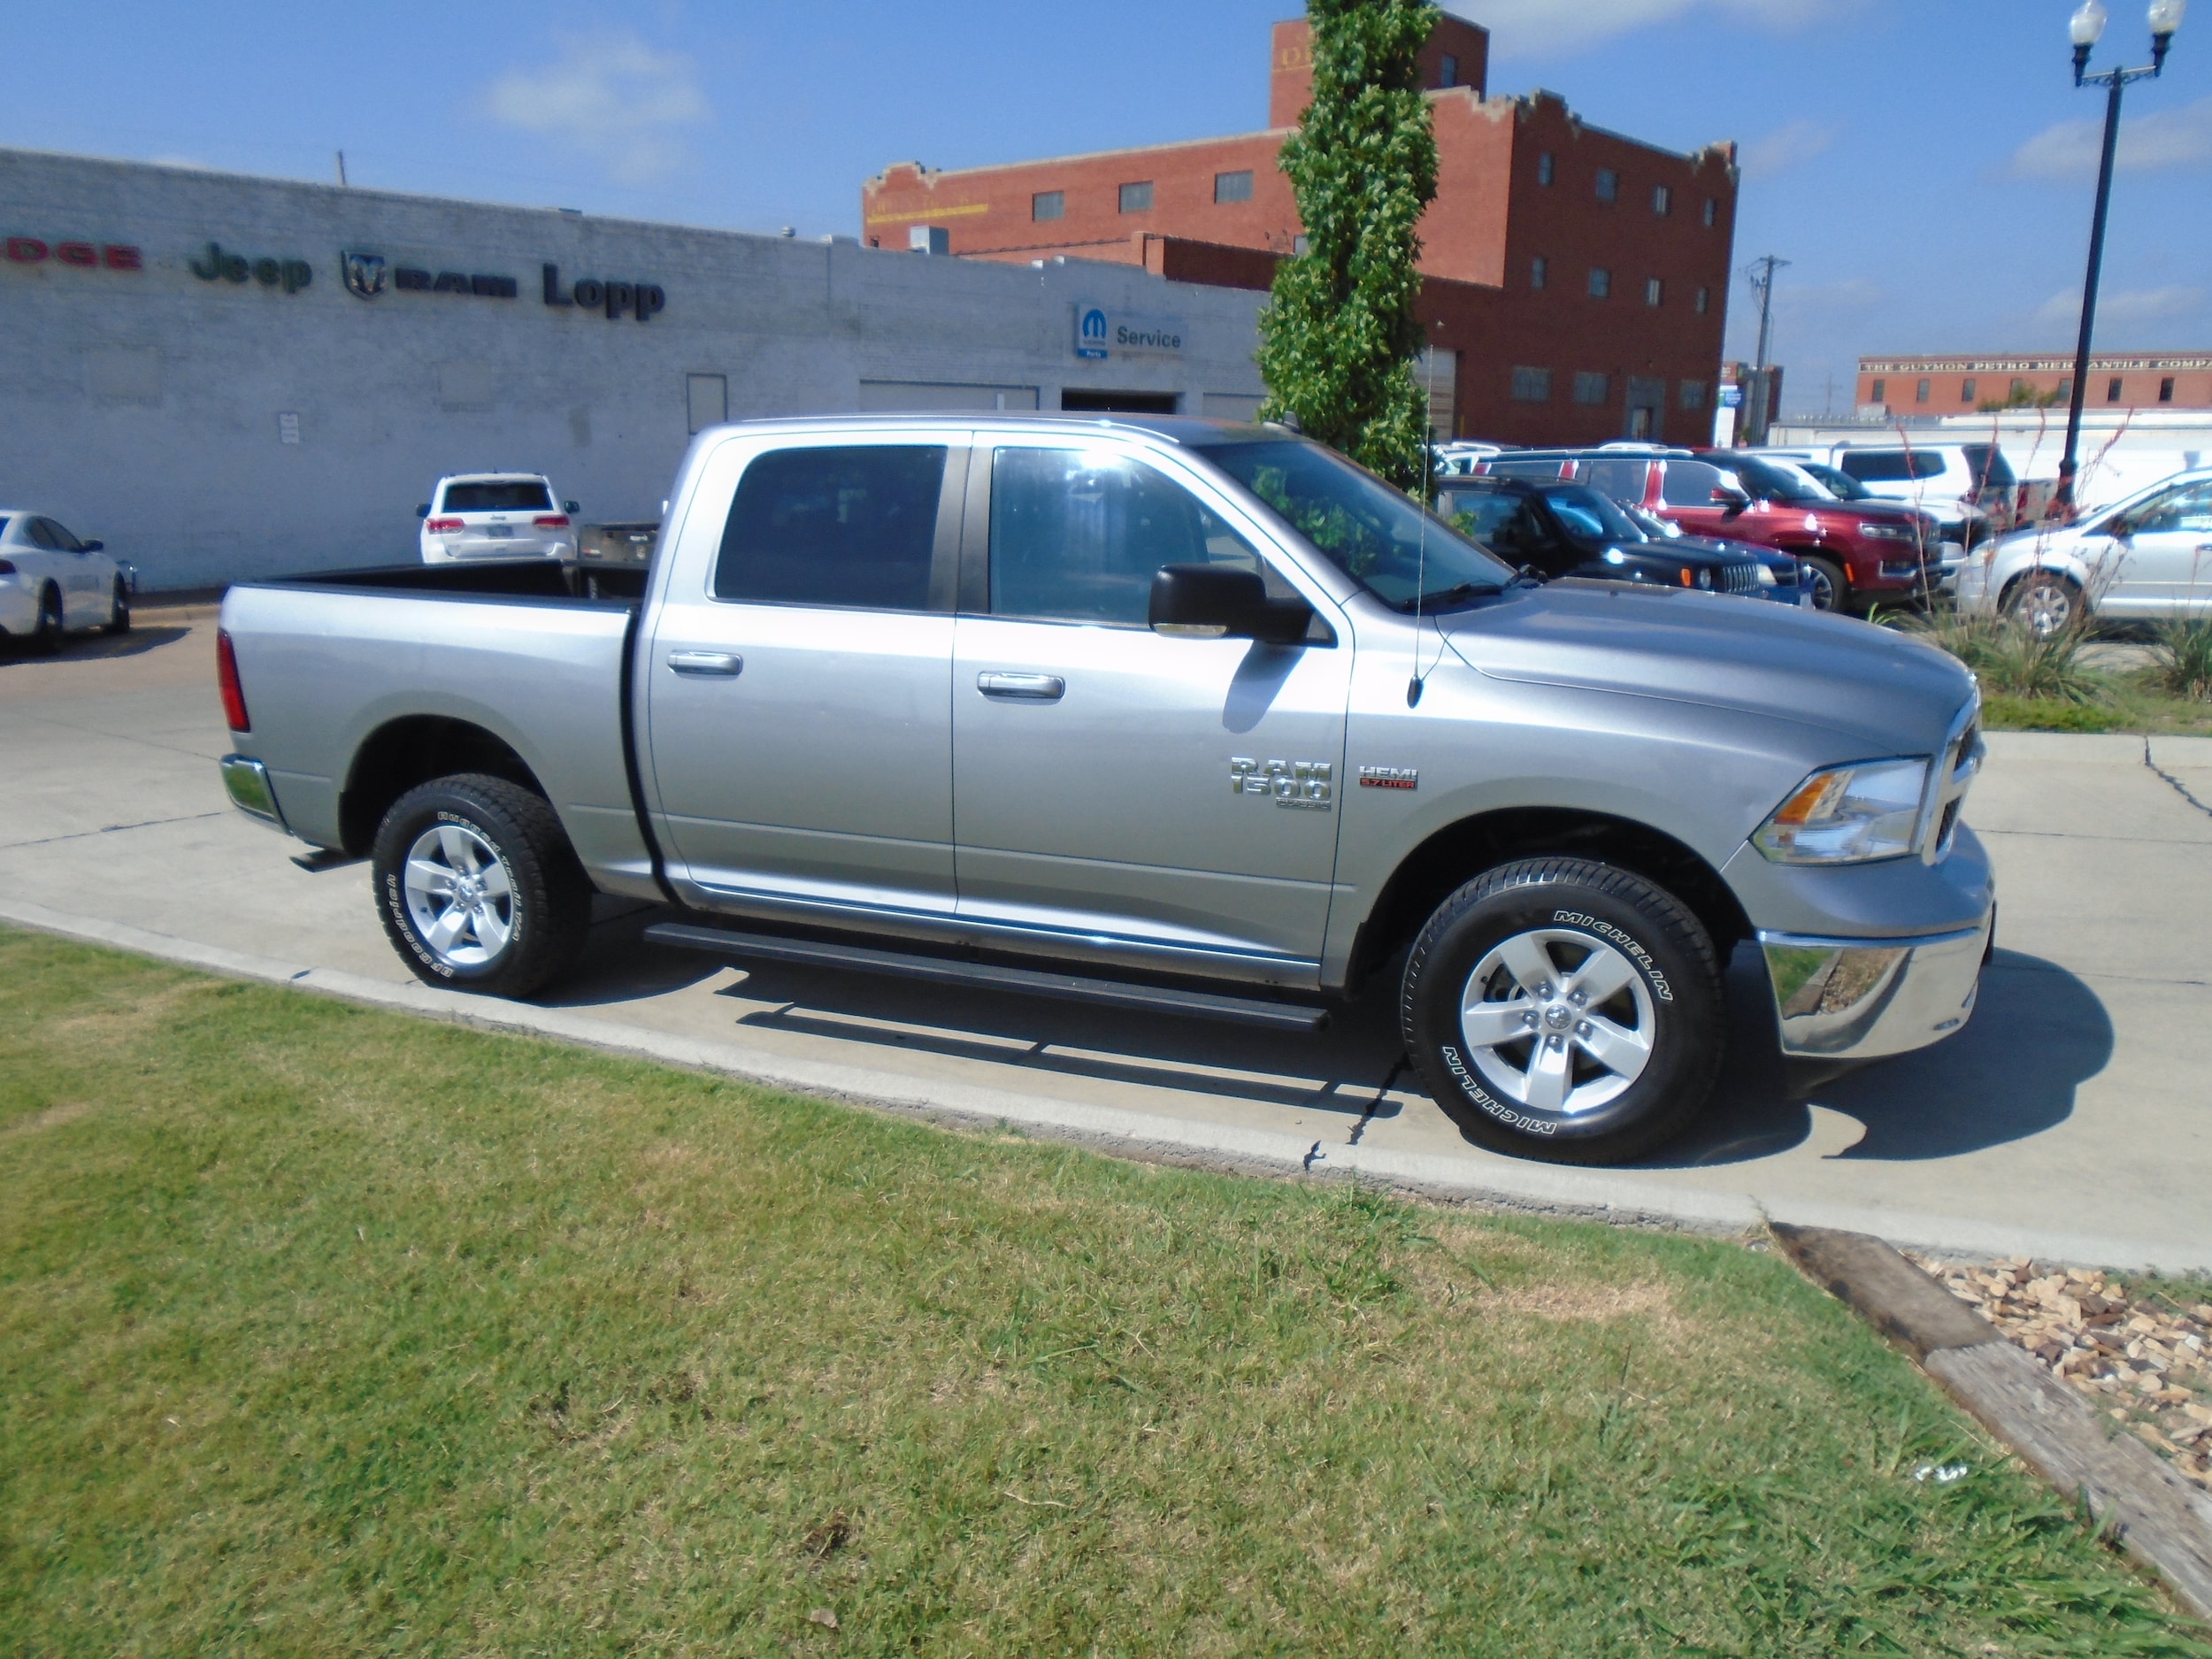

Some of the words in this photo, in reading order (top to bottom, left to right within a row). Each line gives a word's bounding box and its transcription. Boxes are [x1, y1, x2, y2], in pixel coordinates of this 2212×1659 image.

[0, 236, 142, 271] DGE
[190, 242, 313, 295] Jeep
[395, 267, 518, 298] RAM
[542, 262, 666, 321] Lopp
[1117, 326, 1181, 349] Service
[1865, 363, 1894, 372] THE
[1900, 363, 1968, 372] GUYMON
[1974, 362, 2030, 371] PETRO
[2037, 360, 2150, 370] MERANTILE
[1231, 757, 1332, 782] RAM
[1359, 765, 1417, 780] HEMI
[1361, 778, 1379, 787] 5.7
[1381, 779, 1415, 788] LITER
[1231, 775, 1332, 800] 1500
[1553, 910, 1674, 1002] MICHELIN
[1442, 1046, 1558, 1135] MICHELIN
